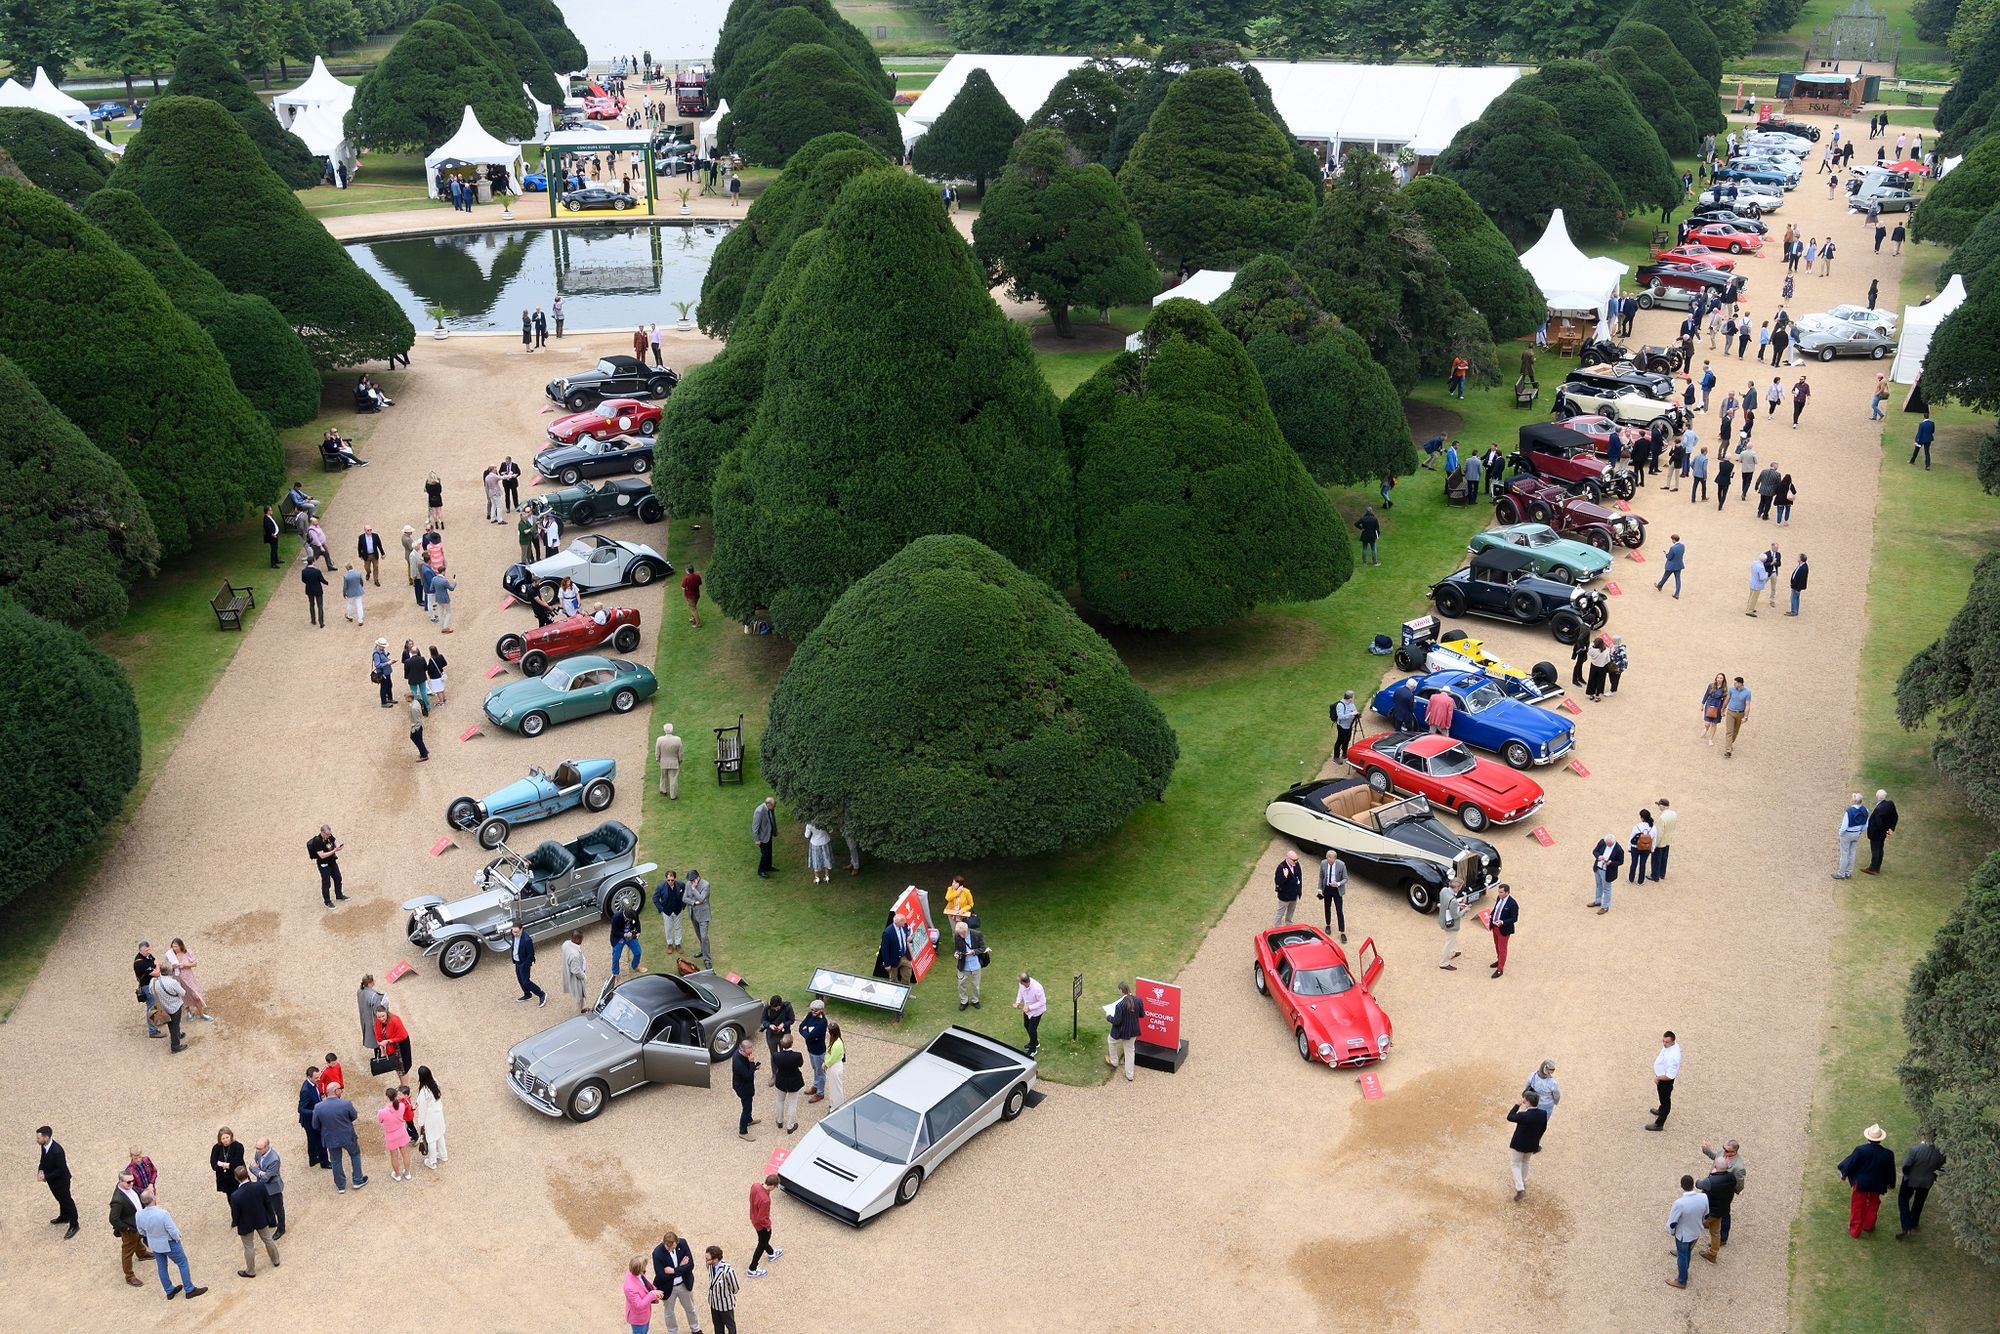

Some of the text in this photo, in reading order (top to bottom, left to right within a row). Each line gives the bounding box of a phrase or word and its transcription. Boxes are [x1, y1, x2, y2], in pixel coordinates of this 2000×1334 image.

[1809, 103, 1829, 111] F&M
[1404, 638, 1410, 646] 5
[1144, 1010, 1174, 1022] ONCOURS
